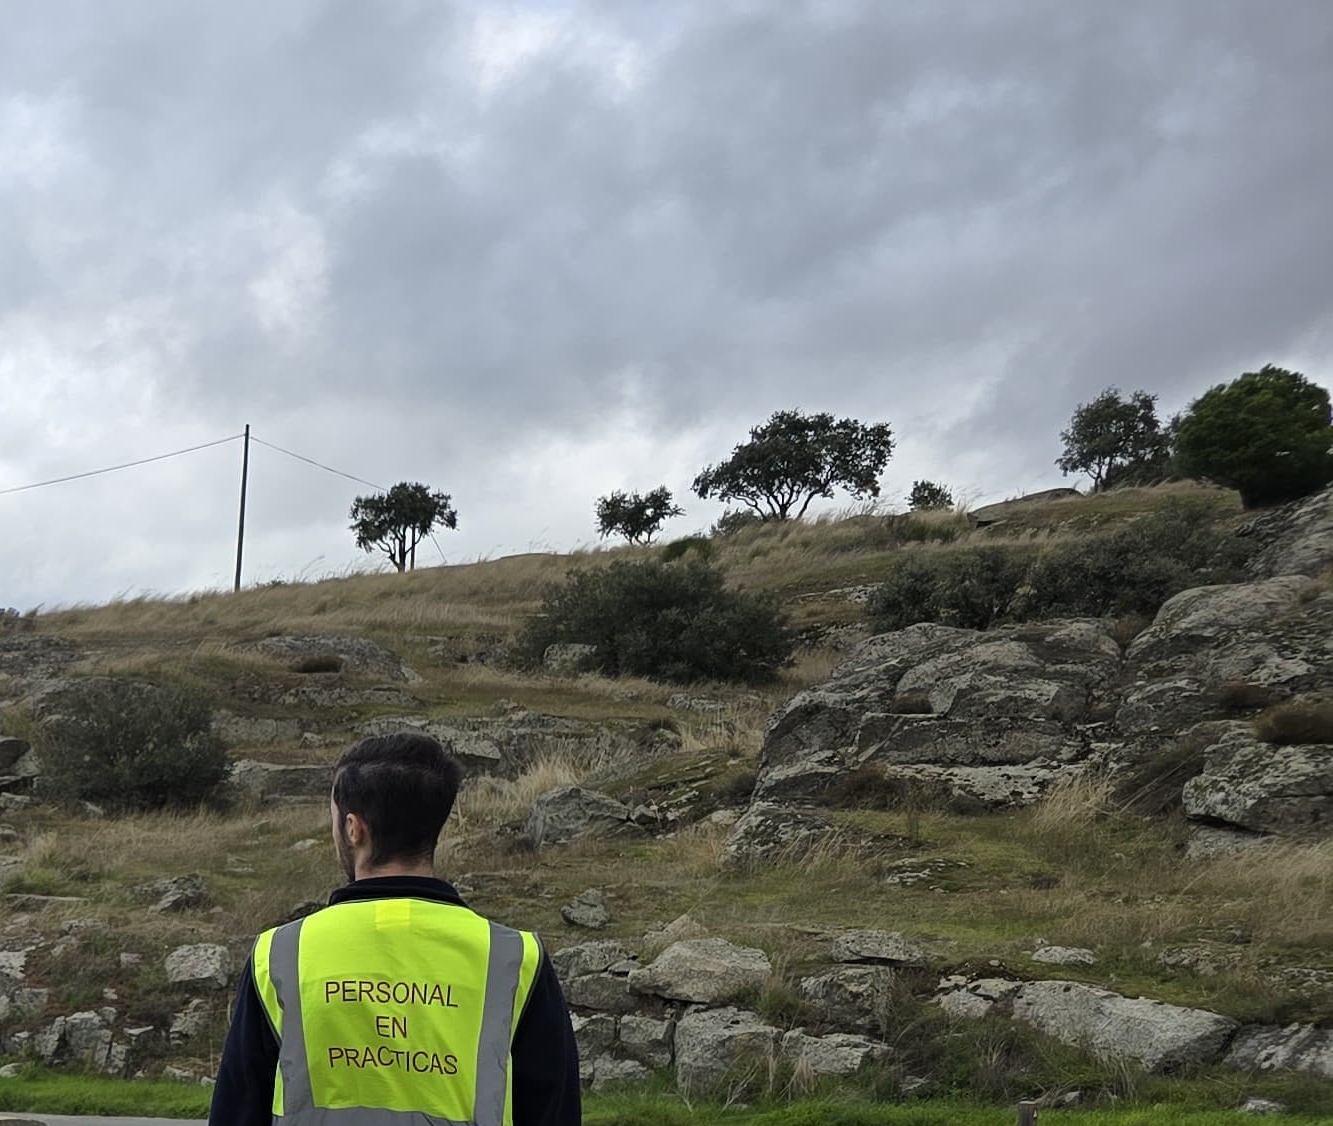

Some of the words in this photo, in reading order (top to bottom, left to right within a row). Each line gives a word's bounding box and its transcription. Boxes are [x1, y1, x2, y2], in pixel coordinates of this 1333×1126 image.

[325, 980, 459, 1008] PERSONAL
[375, 1015, 408, 1039] EN
[328, 1046, 459, 1075] PRACTICAS
